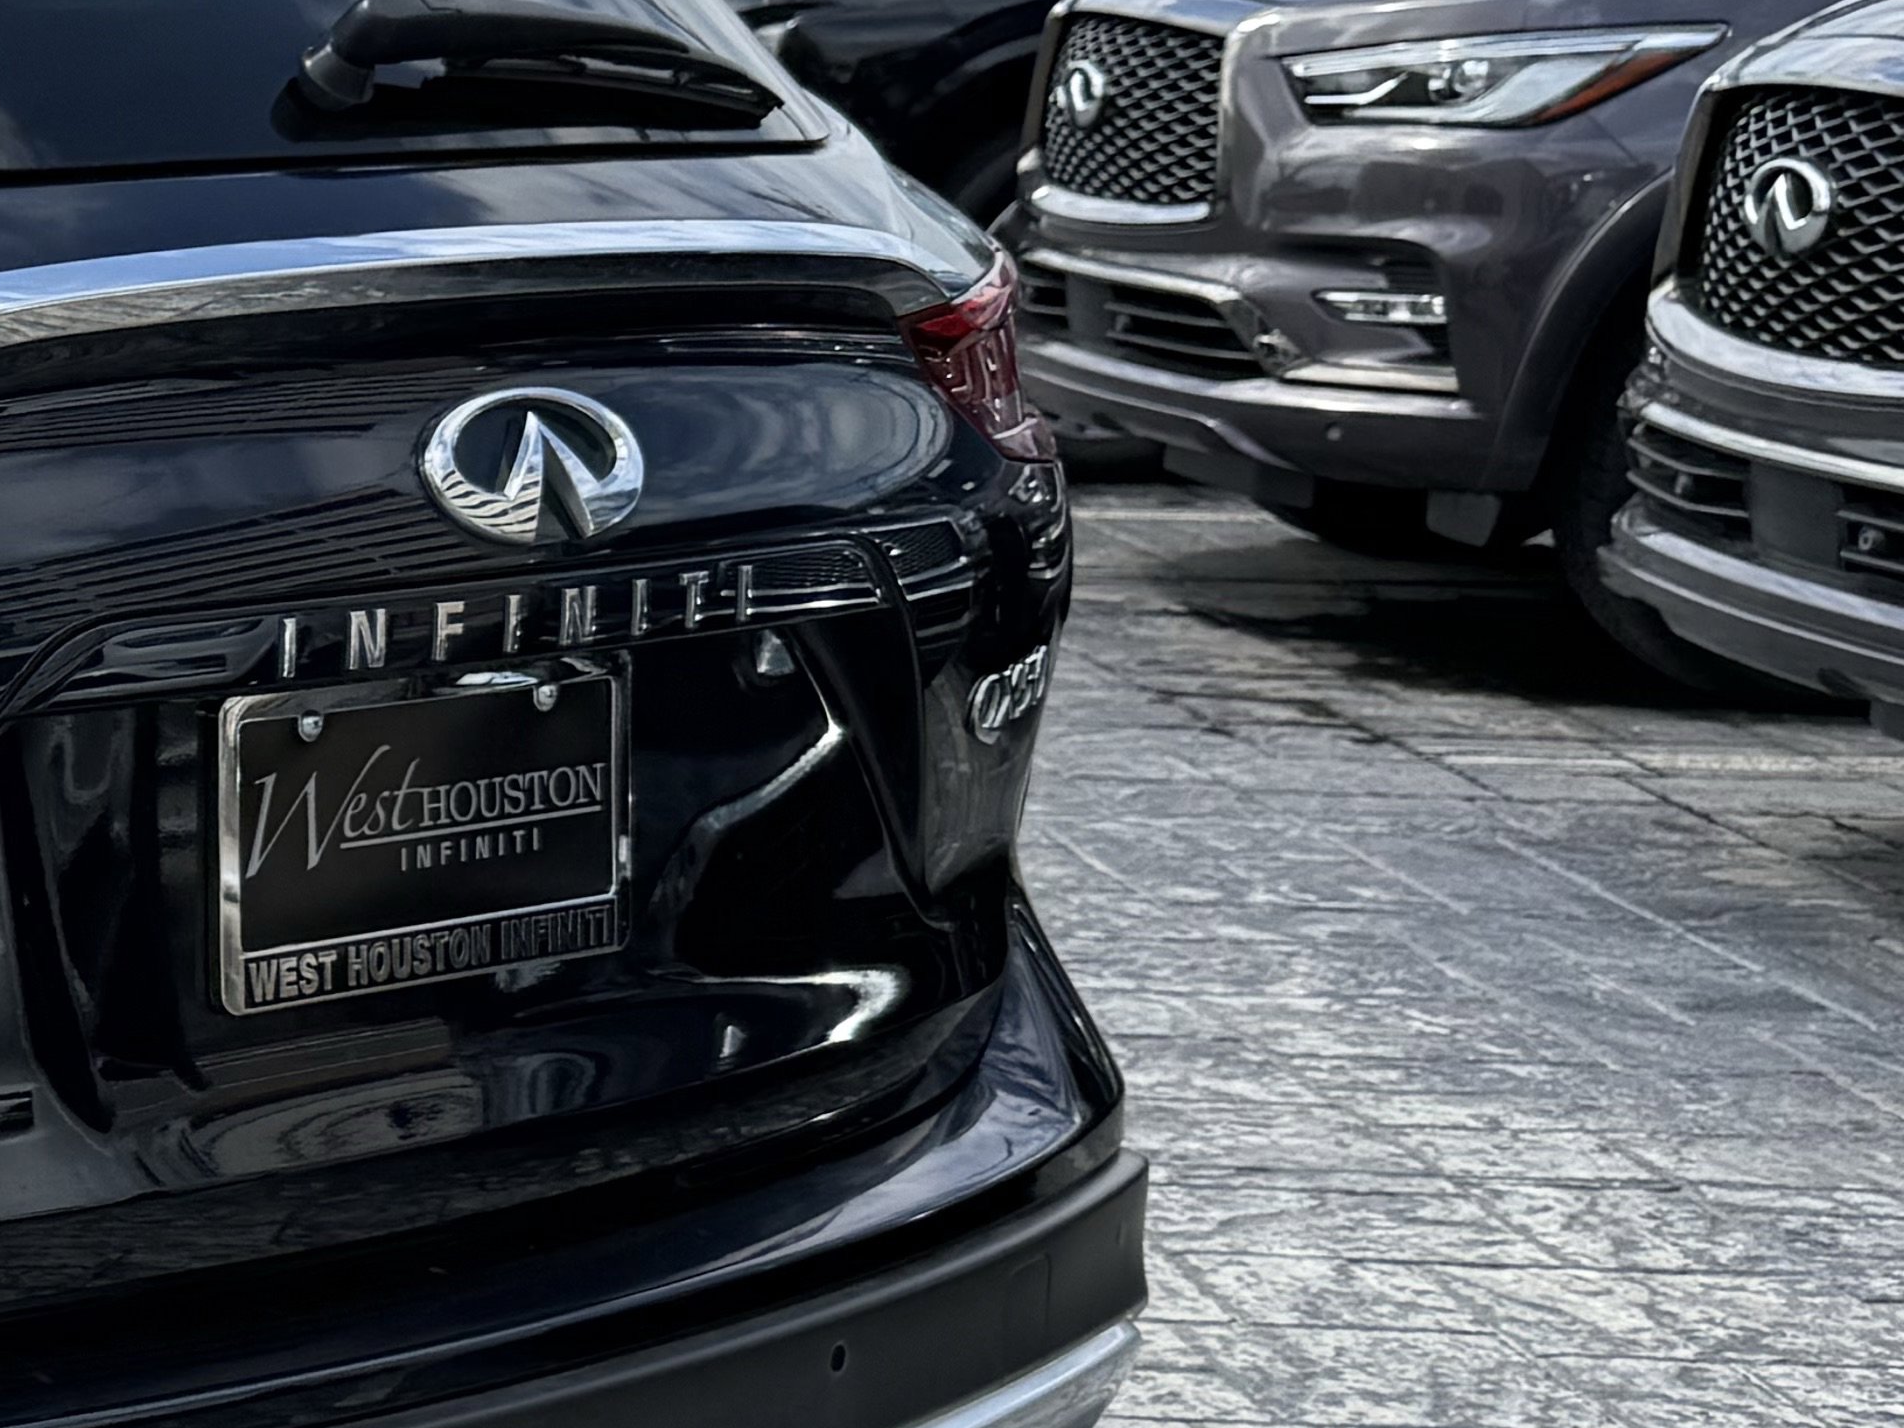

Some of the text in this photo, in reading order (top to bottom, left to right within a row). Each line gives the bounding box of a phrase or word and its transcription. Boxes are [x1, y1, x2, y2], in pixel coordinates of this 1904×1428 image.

[280, 564, 754, 679] INFINITI
[400, 826, 543, 872] INFINITI
[247, 904, 613, 1003] WEST HOUSTON INFINITI
